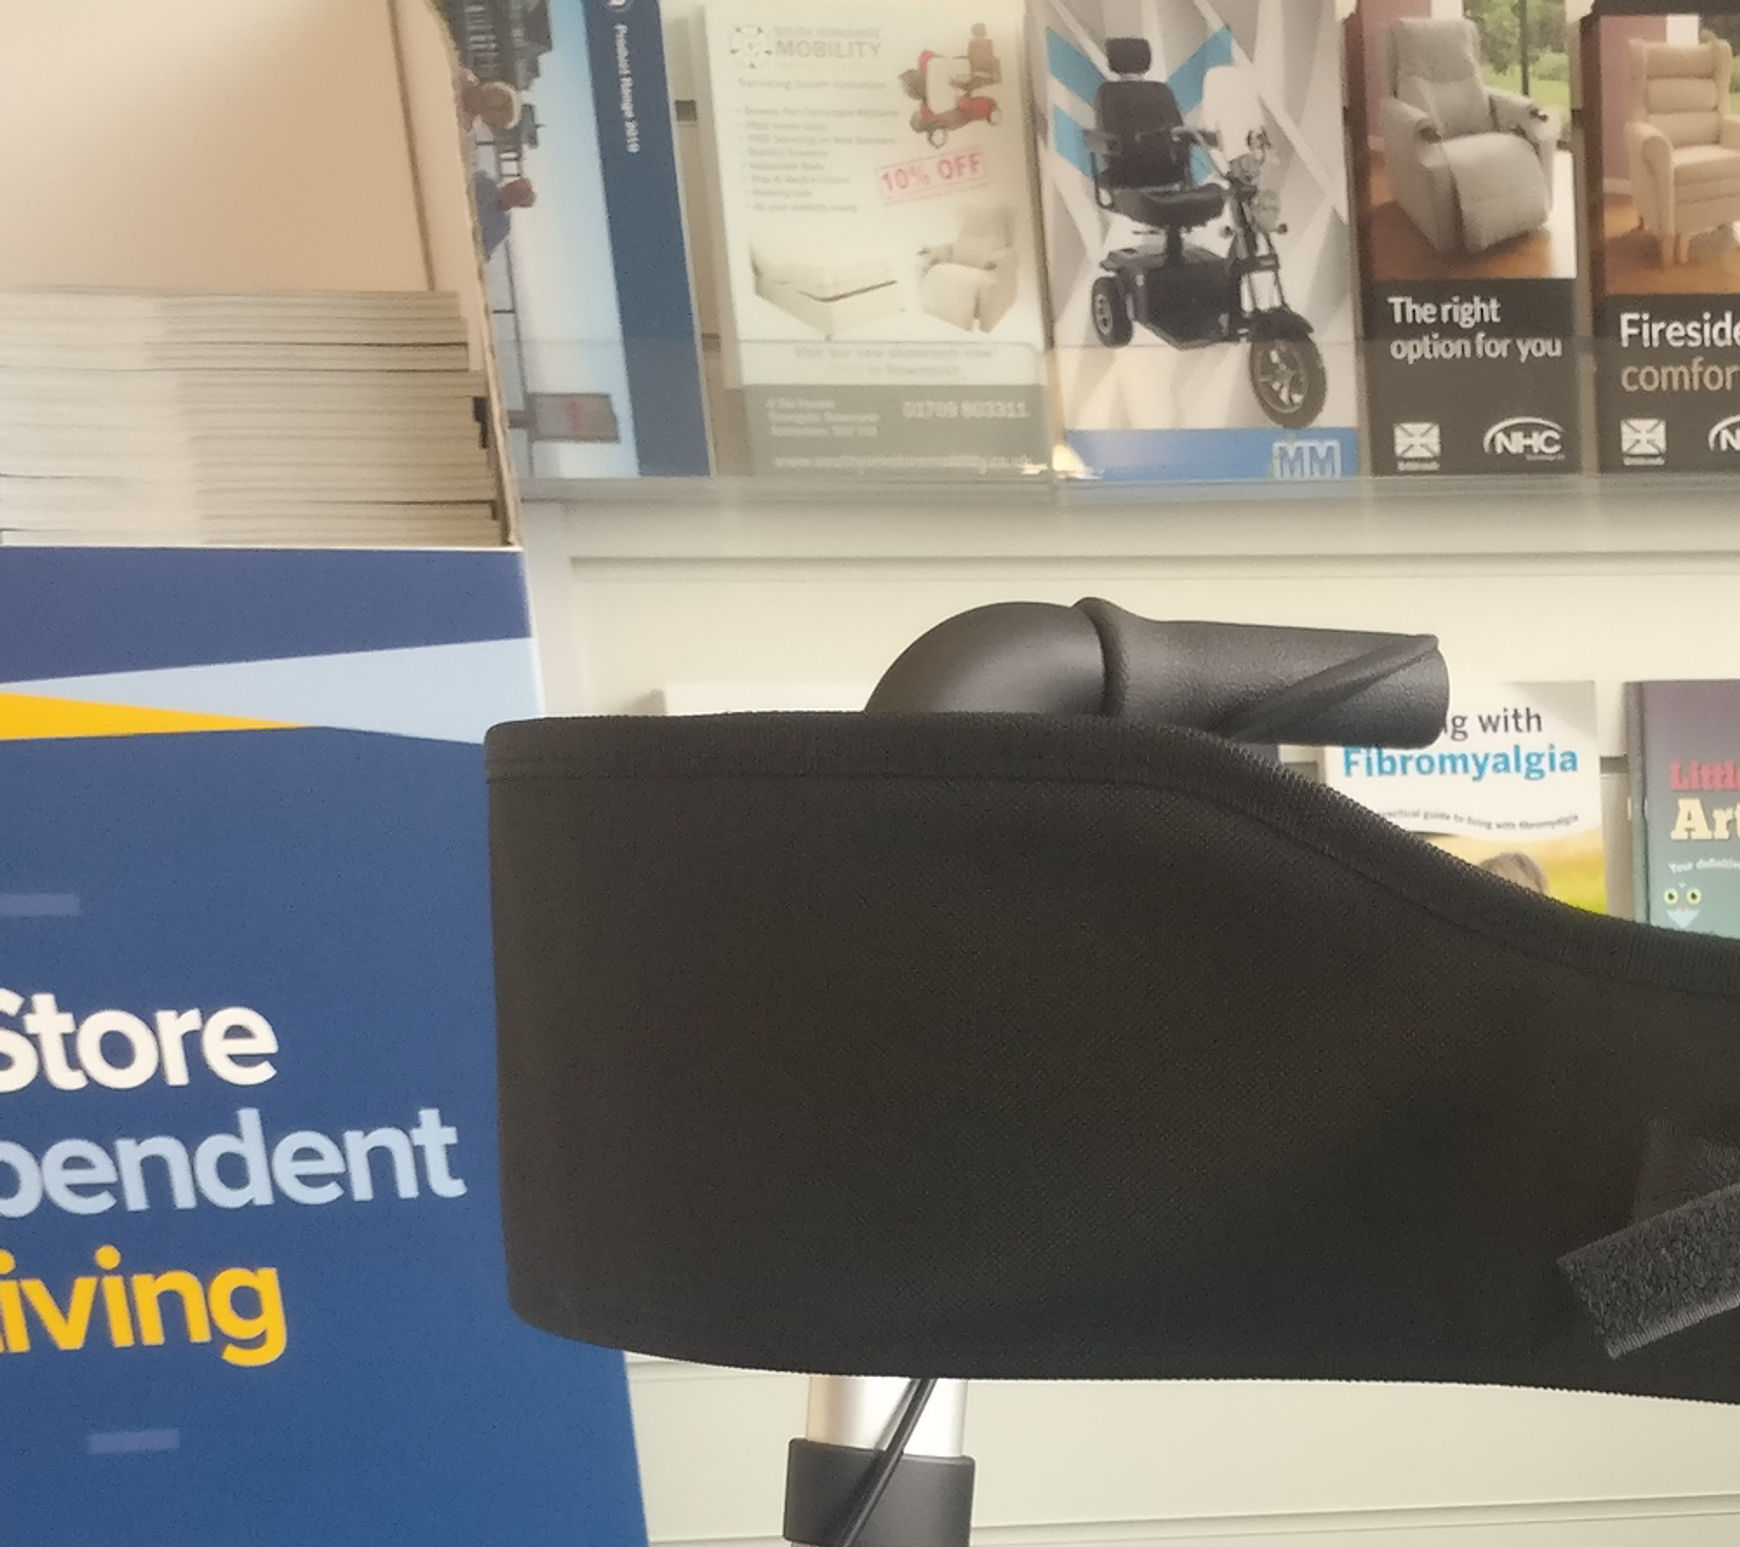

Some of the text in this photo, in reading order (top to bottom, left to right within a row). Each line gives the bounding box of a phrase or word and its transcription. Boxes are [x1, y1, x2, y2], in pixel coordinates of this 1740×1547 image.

[774, 40, 881, 59] MOBILITY
[880, 166, 931, 192] 10%
[937, 152, 982, 180] OFF
[1388, 295, 1501, 329] The right
[1390, 331, 1563, 365] option for you
[1495, 429, 1562, 455] NHC
[1477, 707, 1543, 733] with
[1343, 743, 1579, 782] Fibromyalgia
[0, 987, 278, 1092] Store
[0, 1245, 287, 1367] iving
